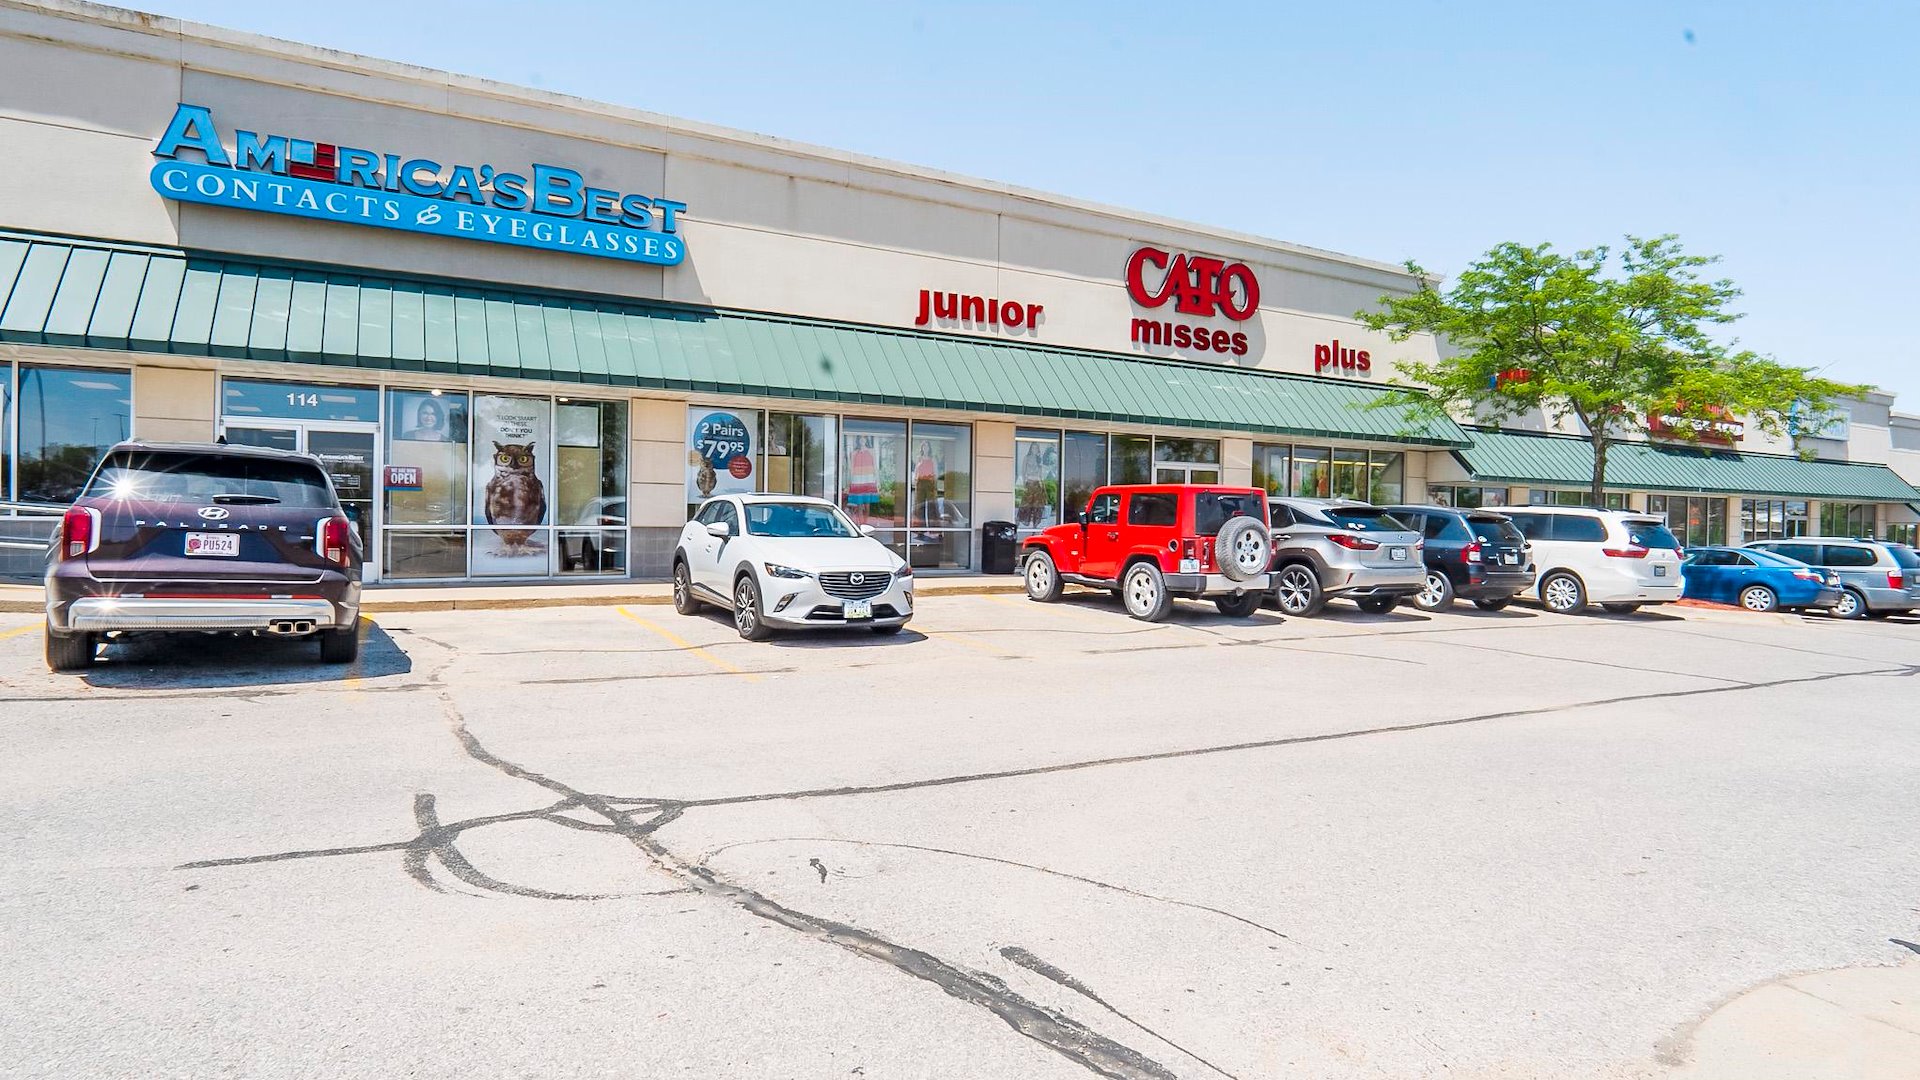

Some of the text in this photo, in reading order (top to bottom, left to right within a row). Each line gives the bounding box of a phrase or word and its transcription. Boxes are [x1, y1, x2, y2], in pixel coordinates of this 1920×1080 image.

[162, 168, 679, 261] CONTACTS & EYEGLASSES
[532, 162, 687, 234] BEST
[1125, 246, 1261, 321] CATO
[914, 289, 1045, 329] junior
[1131, 317, 1249, 356] misses
[1314, 338, 1371, 372] plus
[286, 392, 319, 407] 114
[701, 423, 744, 437] 2 Pairs
[390, 472, 417, 485] OPEN
[135, 520, 288, 532] PALISADE
[203, 539, 233, 551] PU524
